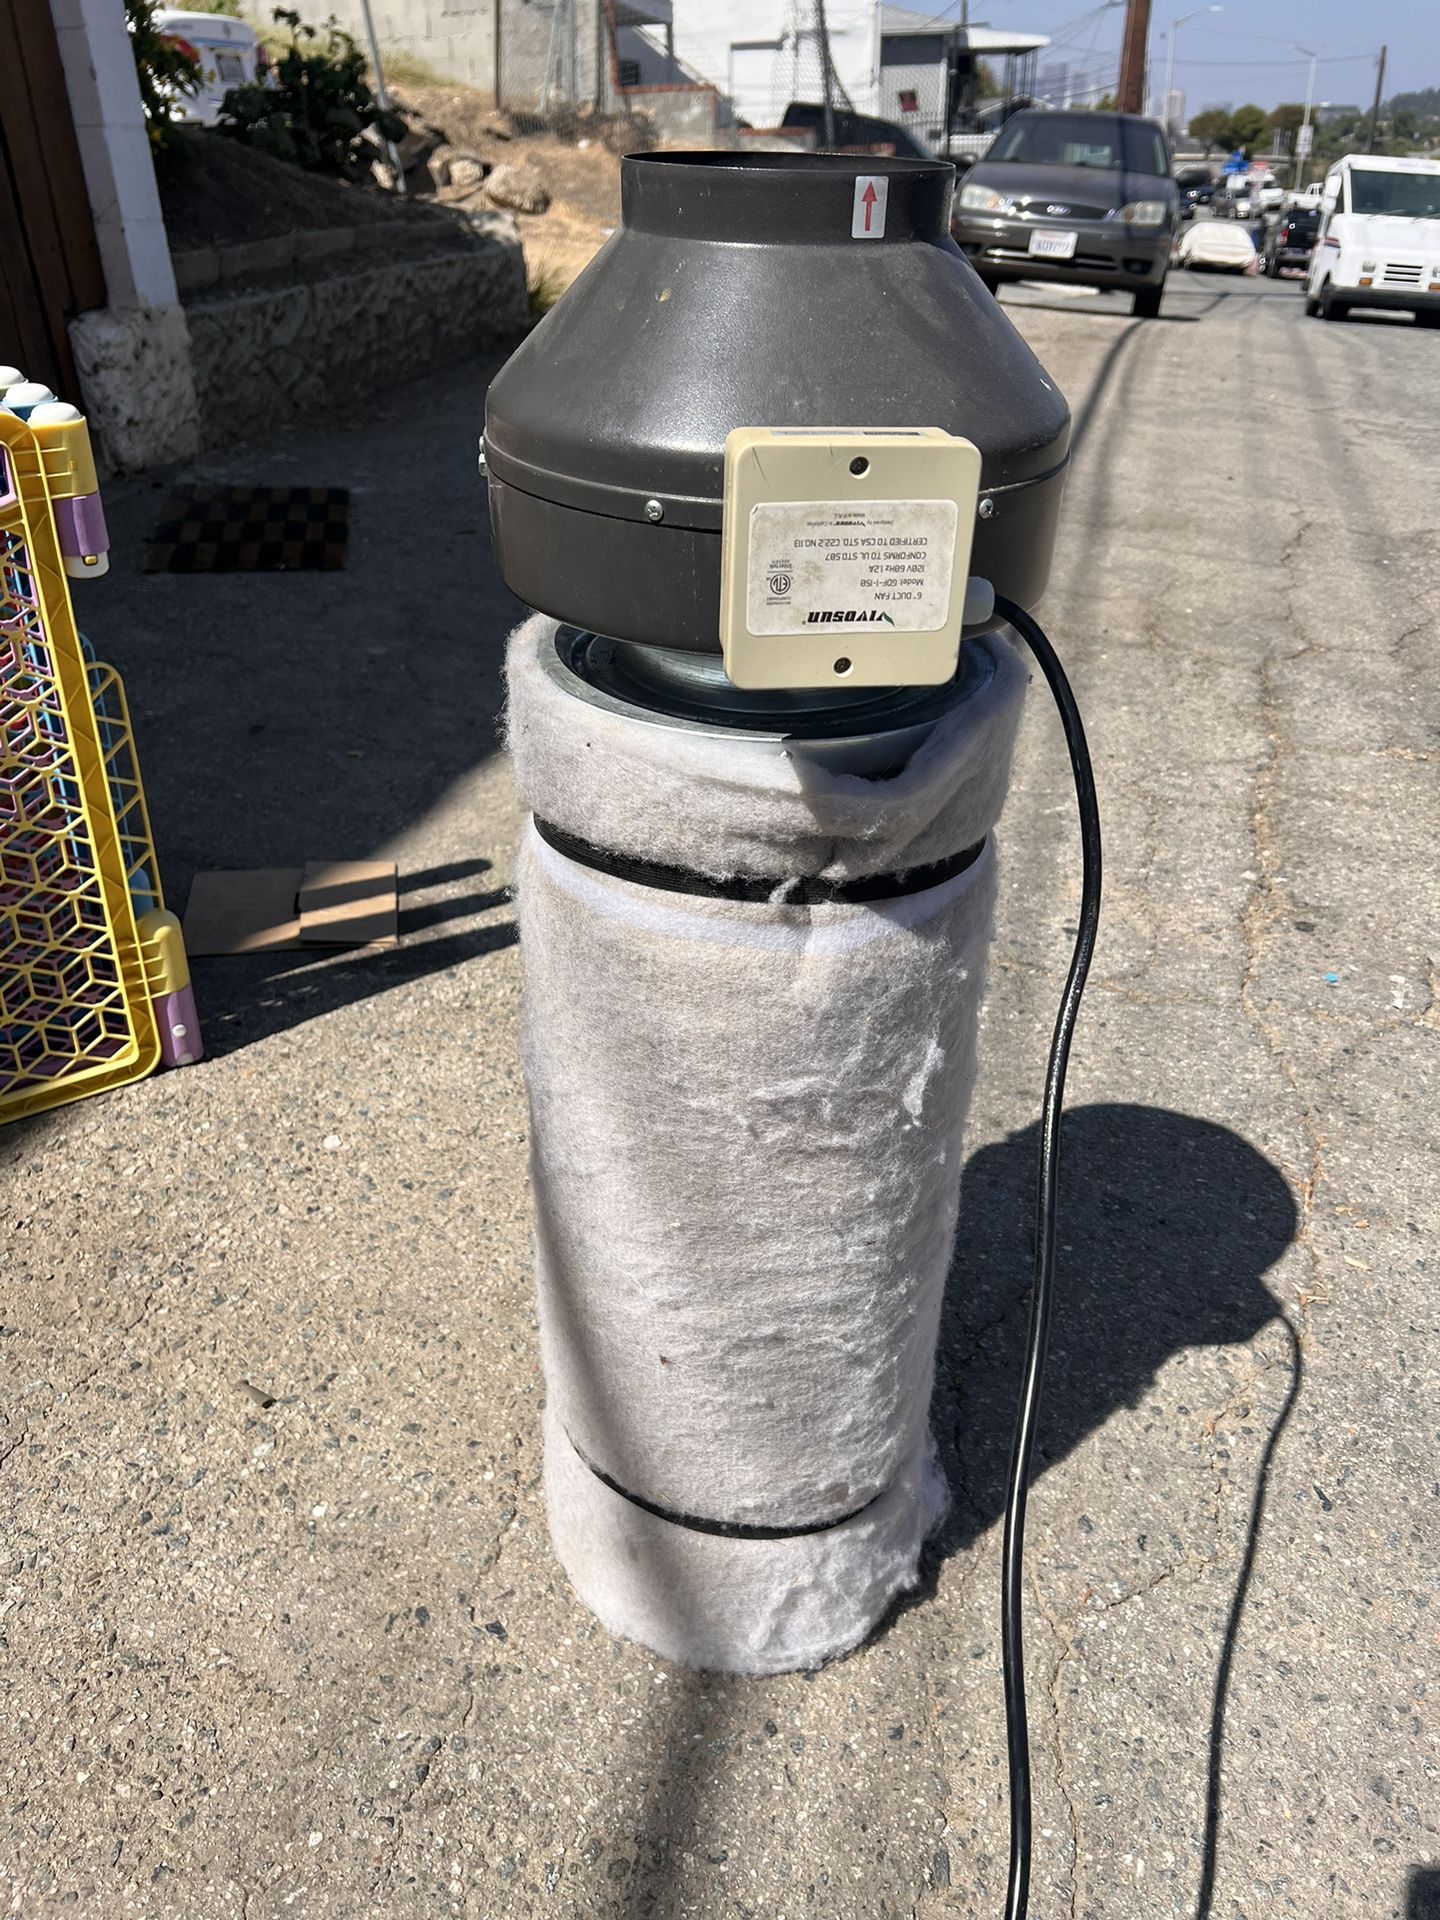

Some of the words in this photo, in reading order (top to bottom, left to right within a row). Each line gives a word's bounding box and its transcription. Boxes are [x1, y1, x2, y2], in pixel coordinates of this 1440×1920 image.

[818, 538, 841, 547] C22.2
[842, 538, 859, 547] STD.
[860, 538, 876, 546] CSA
[877, 538, 887, 546] TO
[889, 537, 928, 546] CERTIFIED
[860, 552, 870, 560] UL
[871, 552, 881, 560] TO
[883, 551, 927, 560] CONFORMS
[868, 565, 883, 573] 1.2A
[885, 565, 906, 573] 60Hz
[906, 564, 925, 573] 120V
[874, 592, 890, 601] FAN
[891, 592, 912, 600] DUCT
